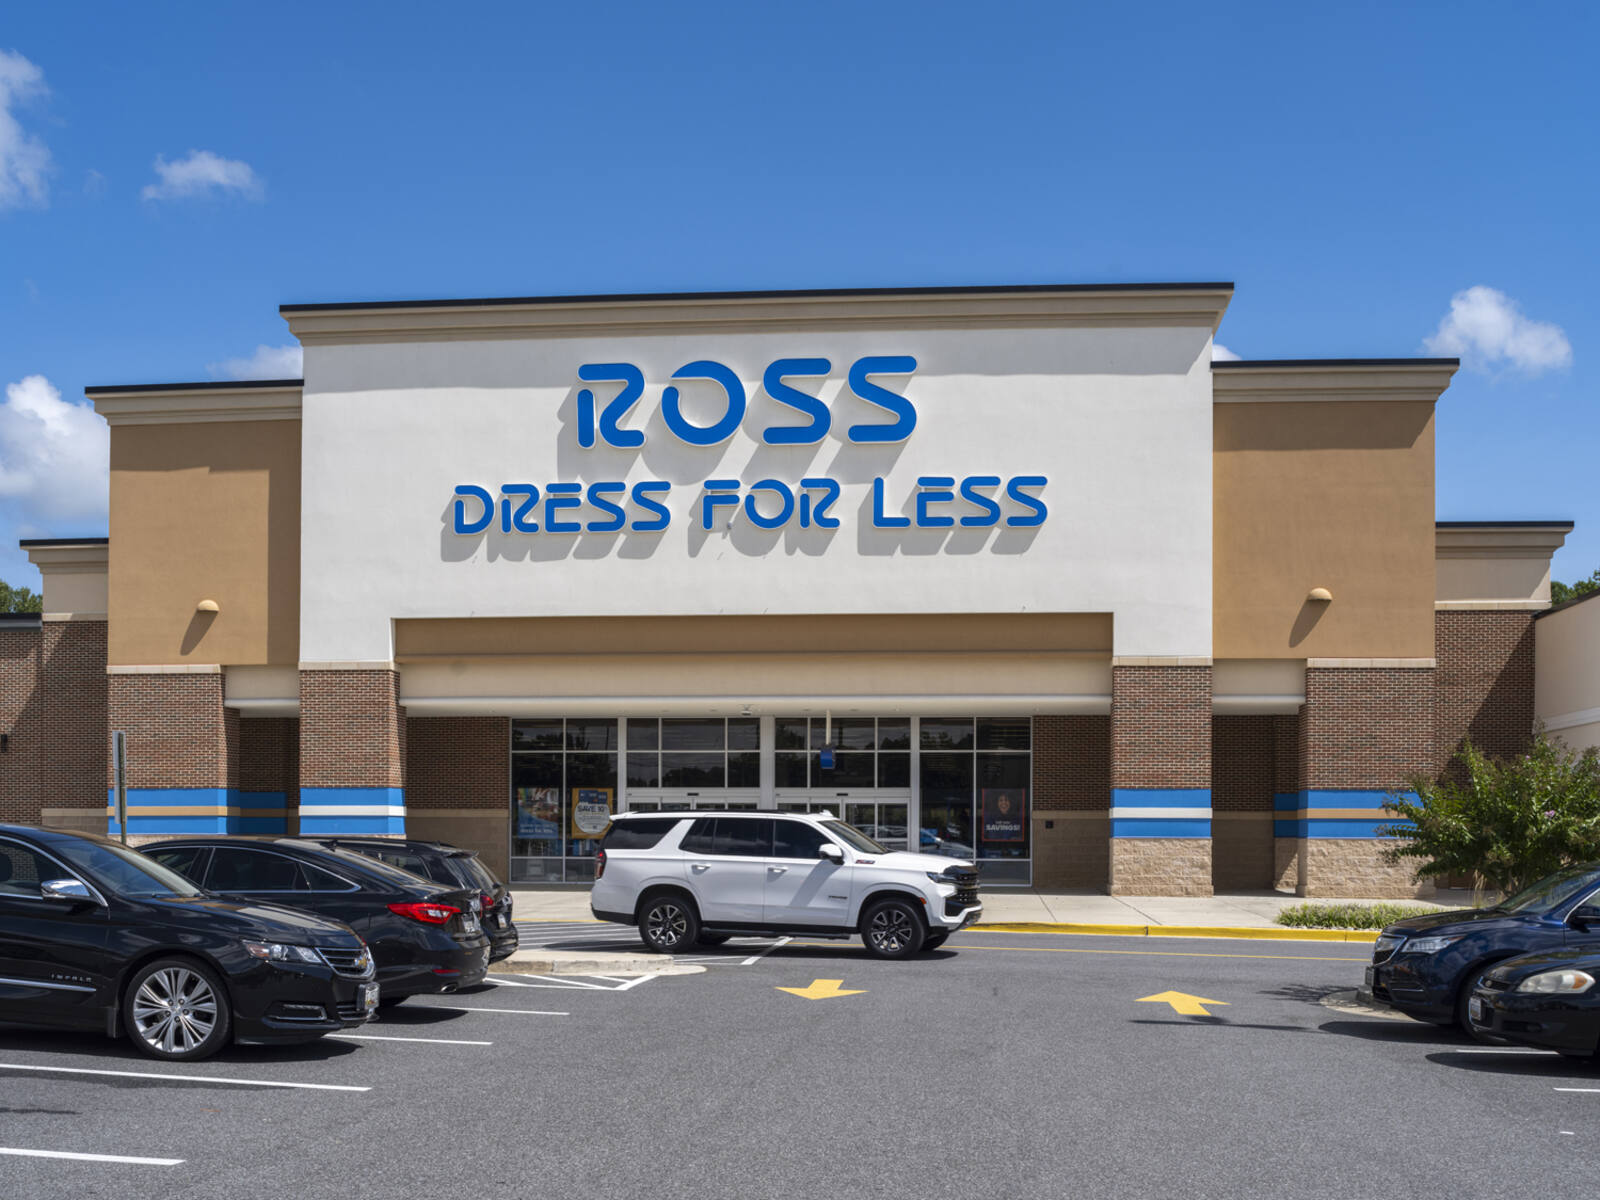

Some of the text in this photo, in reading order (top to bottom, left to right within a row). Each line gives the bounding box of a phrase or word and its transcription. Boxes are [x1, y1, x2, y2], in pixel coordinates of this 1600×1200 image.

[577, 355, 918, 449] ROSS
[454, 475, 1048, 534] DRESS FOR LESS
